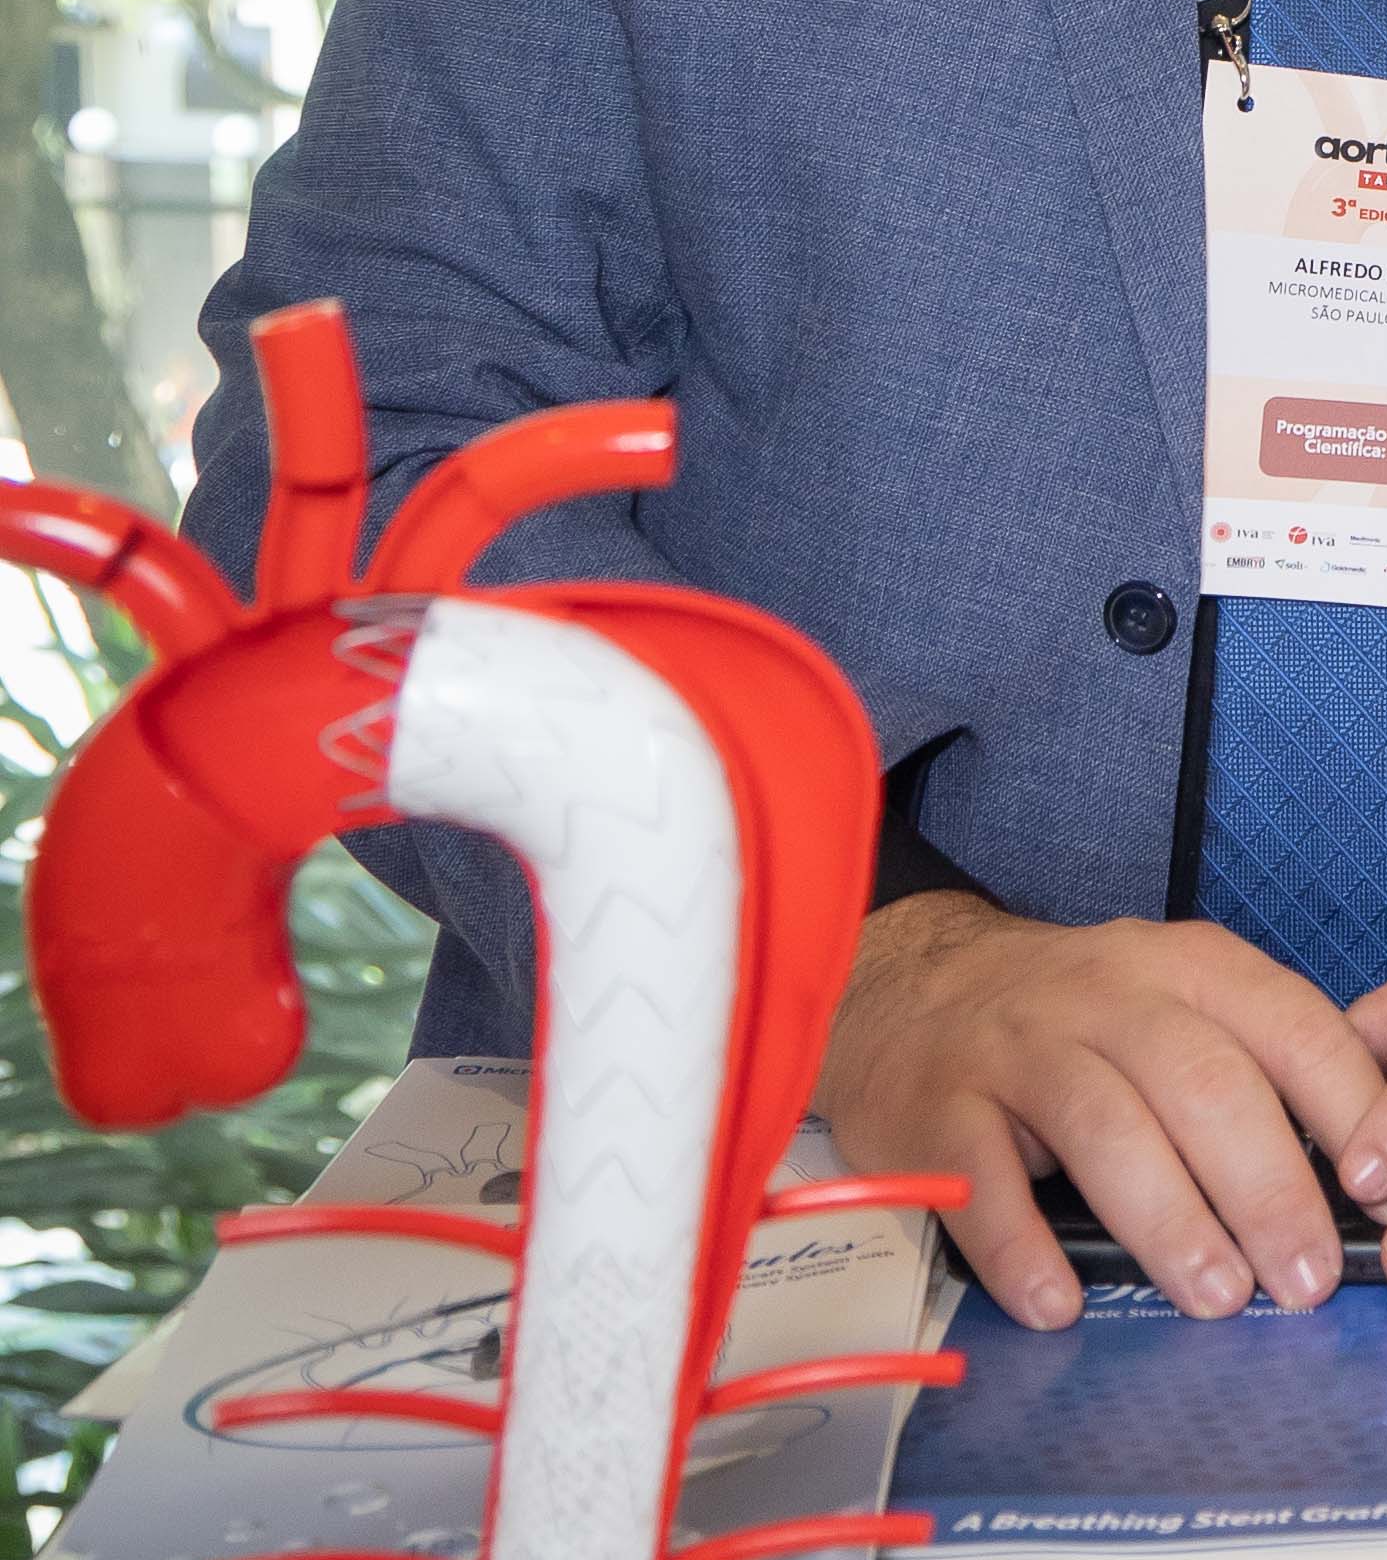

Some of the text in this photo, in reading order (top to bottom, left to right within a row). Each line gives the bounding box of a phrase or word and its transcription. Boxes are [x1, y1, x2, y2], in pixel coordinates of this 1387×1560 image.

[1295, 258, 1383, 281] ALFREDO
[1268, 282, 1385, 304] MICROMEDICAL
[1311, 305, 1341, 321] SÃO
[1276, 420, 1387, 442] Programação
[1304, 439, 1386, 459] Científica:
[953, 1512, 982, 1532] A
[989, 1511, 1185, 1534] Breathing
[1190, 1508, 1294, 1530] Stent
